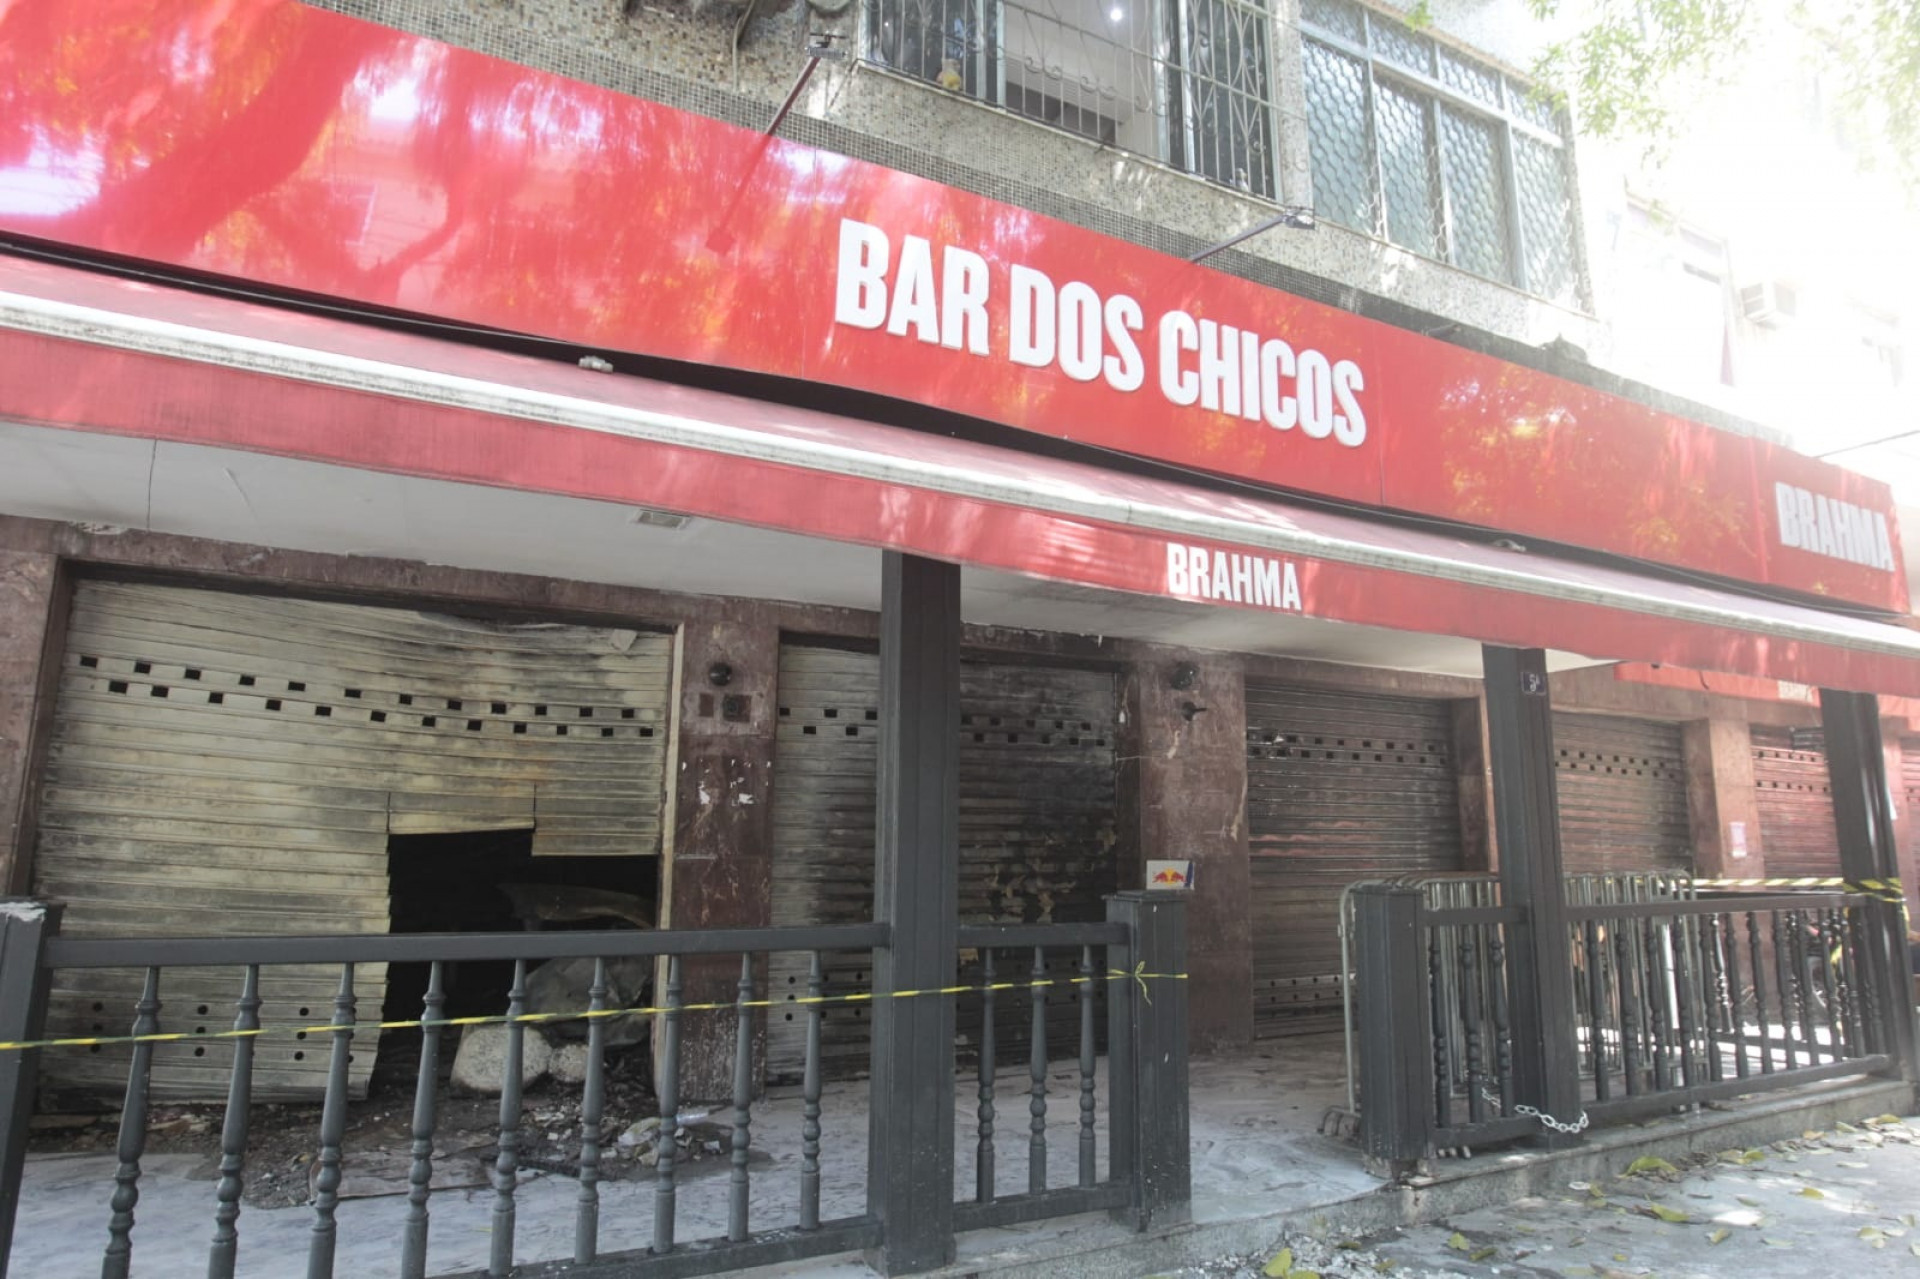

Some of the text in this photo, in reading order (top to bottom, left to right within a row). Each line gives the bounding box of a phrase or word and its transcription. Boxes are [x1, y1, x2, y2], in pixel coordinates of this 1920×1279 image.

[835, 218, 1367, 447] BAR DOS CHICOS
[1775, 481, 1896, 572] BRAHMA
[1166, 542, 1301, 610] BRAHMA
